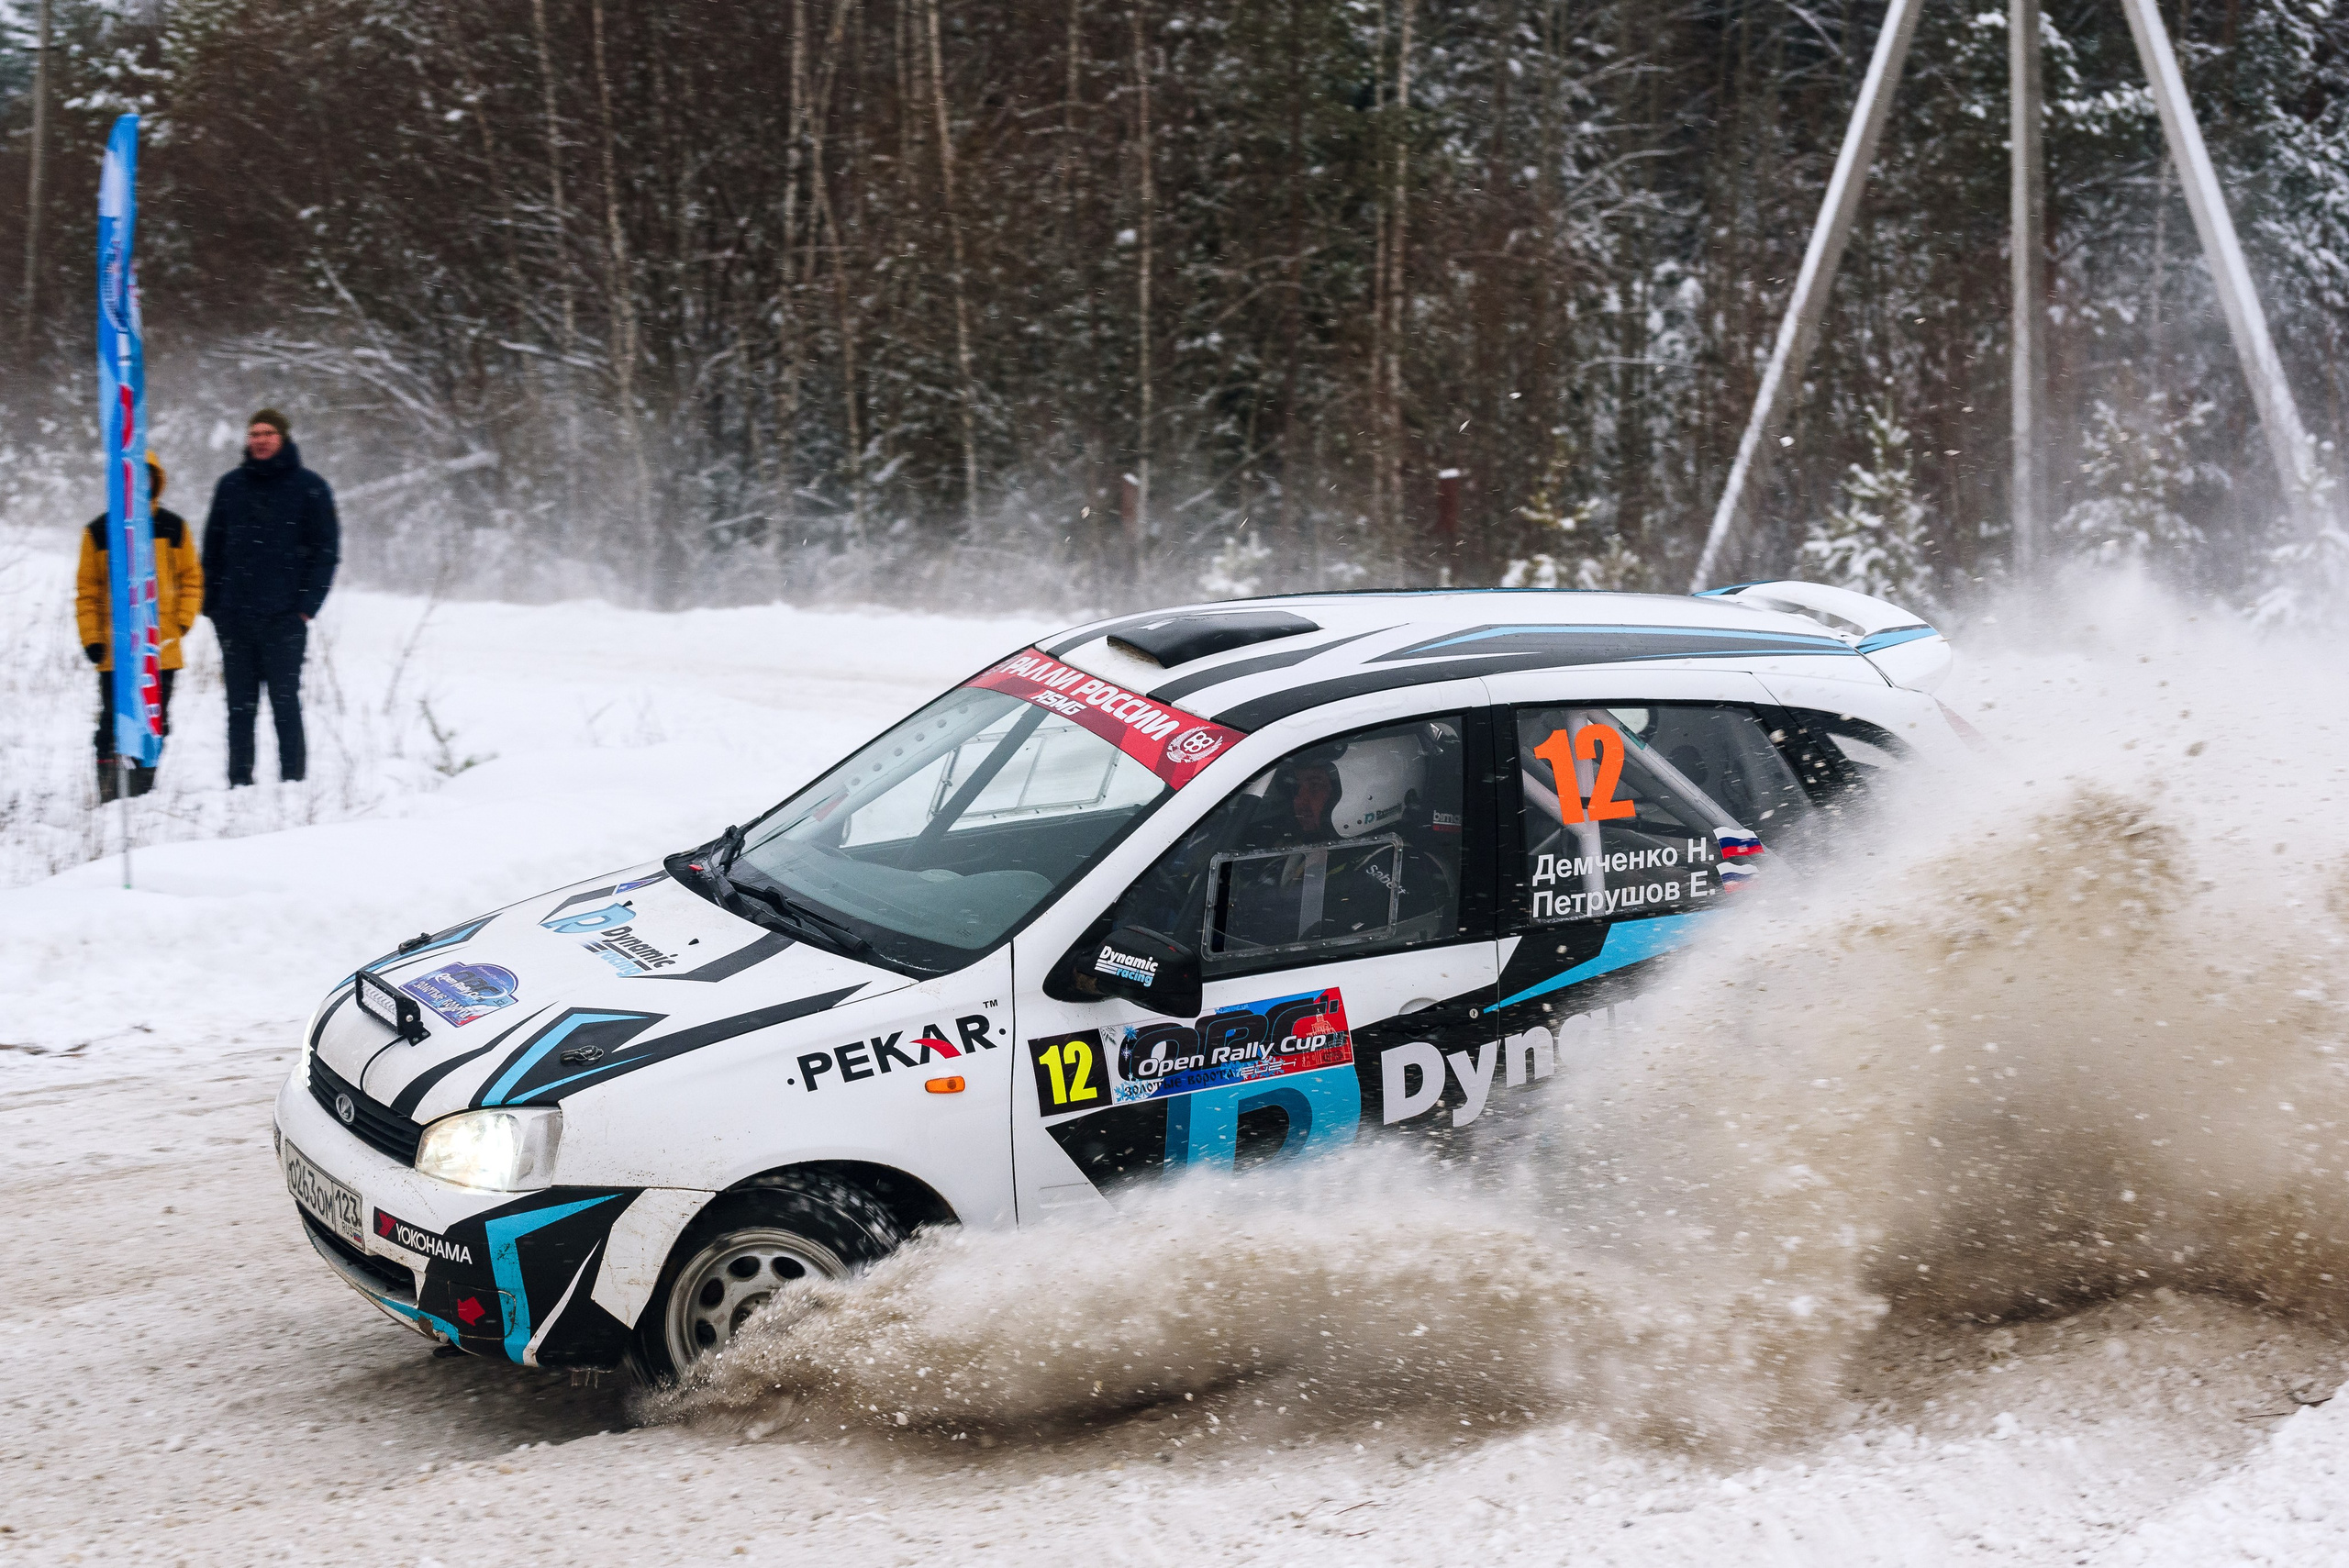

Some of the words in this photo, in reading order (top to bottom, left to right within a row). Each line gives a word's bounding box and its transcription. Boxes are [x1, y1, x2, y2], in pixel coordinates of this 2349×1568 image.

[999, 656, 1085, 691] РАЛЛИ
[1070, 679, 1181, 742] РОССИИ
[1533, 723, 1636, 825] 12
[1532, 845, 1678, 886] Демченко
[1687, 837, 1715, 863] Н.
[1532, 880, 1681, 917] Петрушов
[1690, 870, 1716, 898] Е.
[595, 949, 644, 978] racing
[601, 926, 679, 968] Dynamic
[1099, 945, 1159, 973] Dynamic
[1116, 969, 1153, 987] racing
[983, 999, 998, 1008] TM
[796, 1014, 997, 1092] PEKAR
[1039, 1040, 1097, 1105] 12
[1138, 1054, 1205, 1076] Open
[1211, 1041, 1275, 1064] Rally
[1280, 1034, 1327, 1052] Cup
[335, 1189, 359, 1228] 123
[395, 1223, 473, 1264] YOKOHAMA
